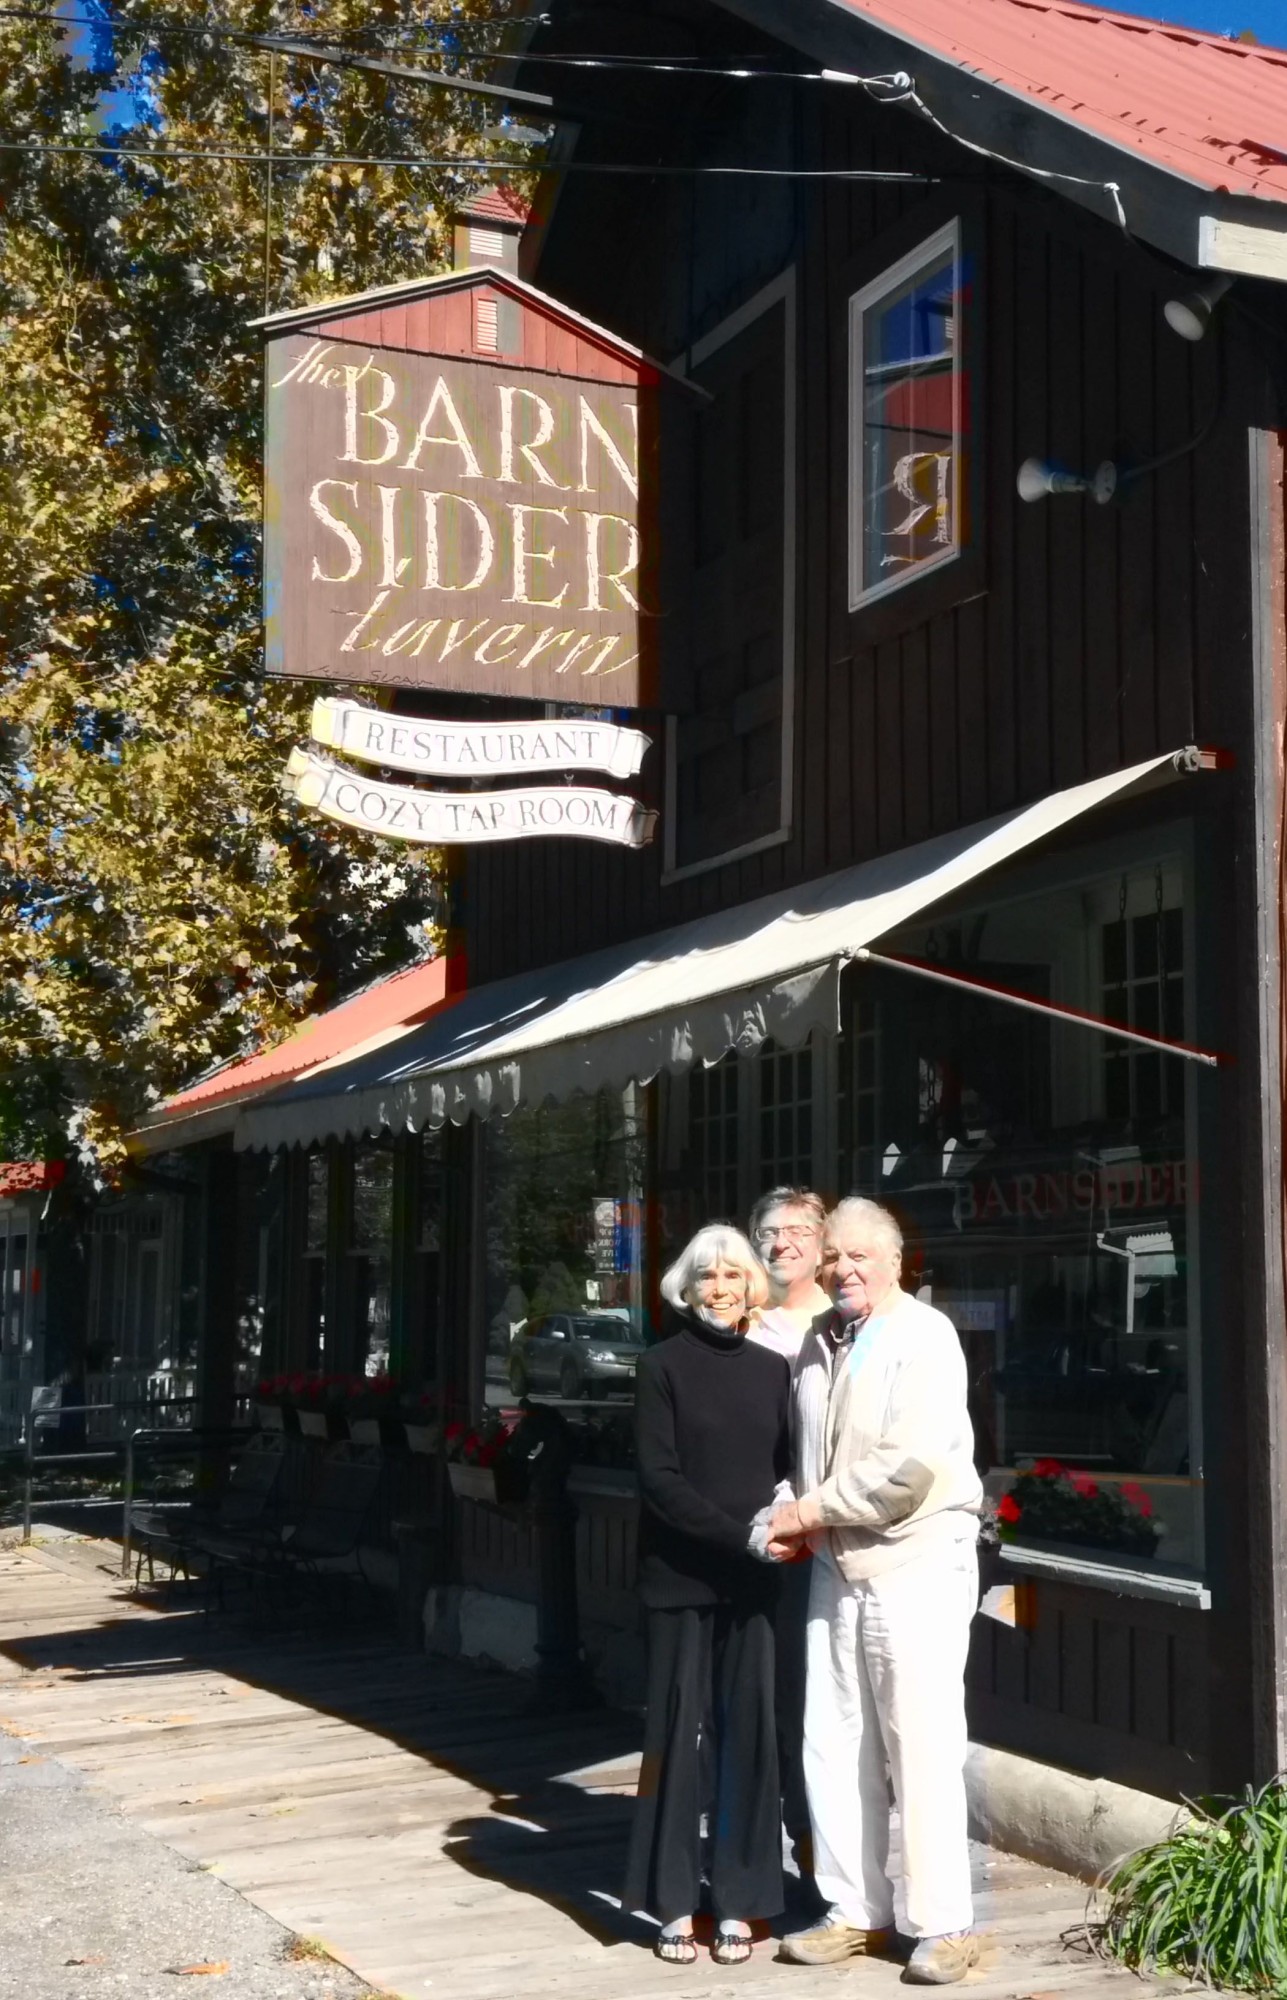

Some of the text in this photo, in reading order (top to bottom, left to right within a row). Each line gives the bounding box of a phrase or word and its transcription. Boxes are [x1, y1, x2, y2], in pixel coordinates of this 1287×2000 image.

[334, 365, 640, 501] BARN
[309, 477, 668, 616] SIDER
[365, 721, 601, 764] RESTAURANT
[335, 784, 619, 833] COZY TAP ROOM
